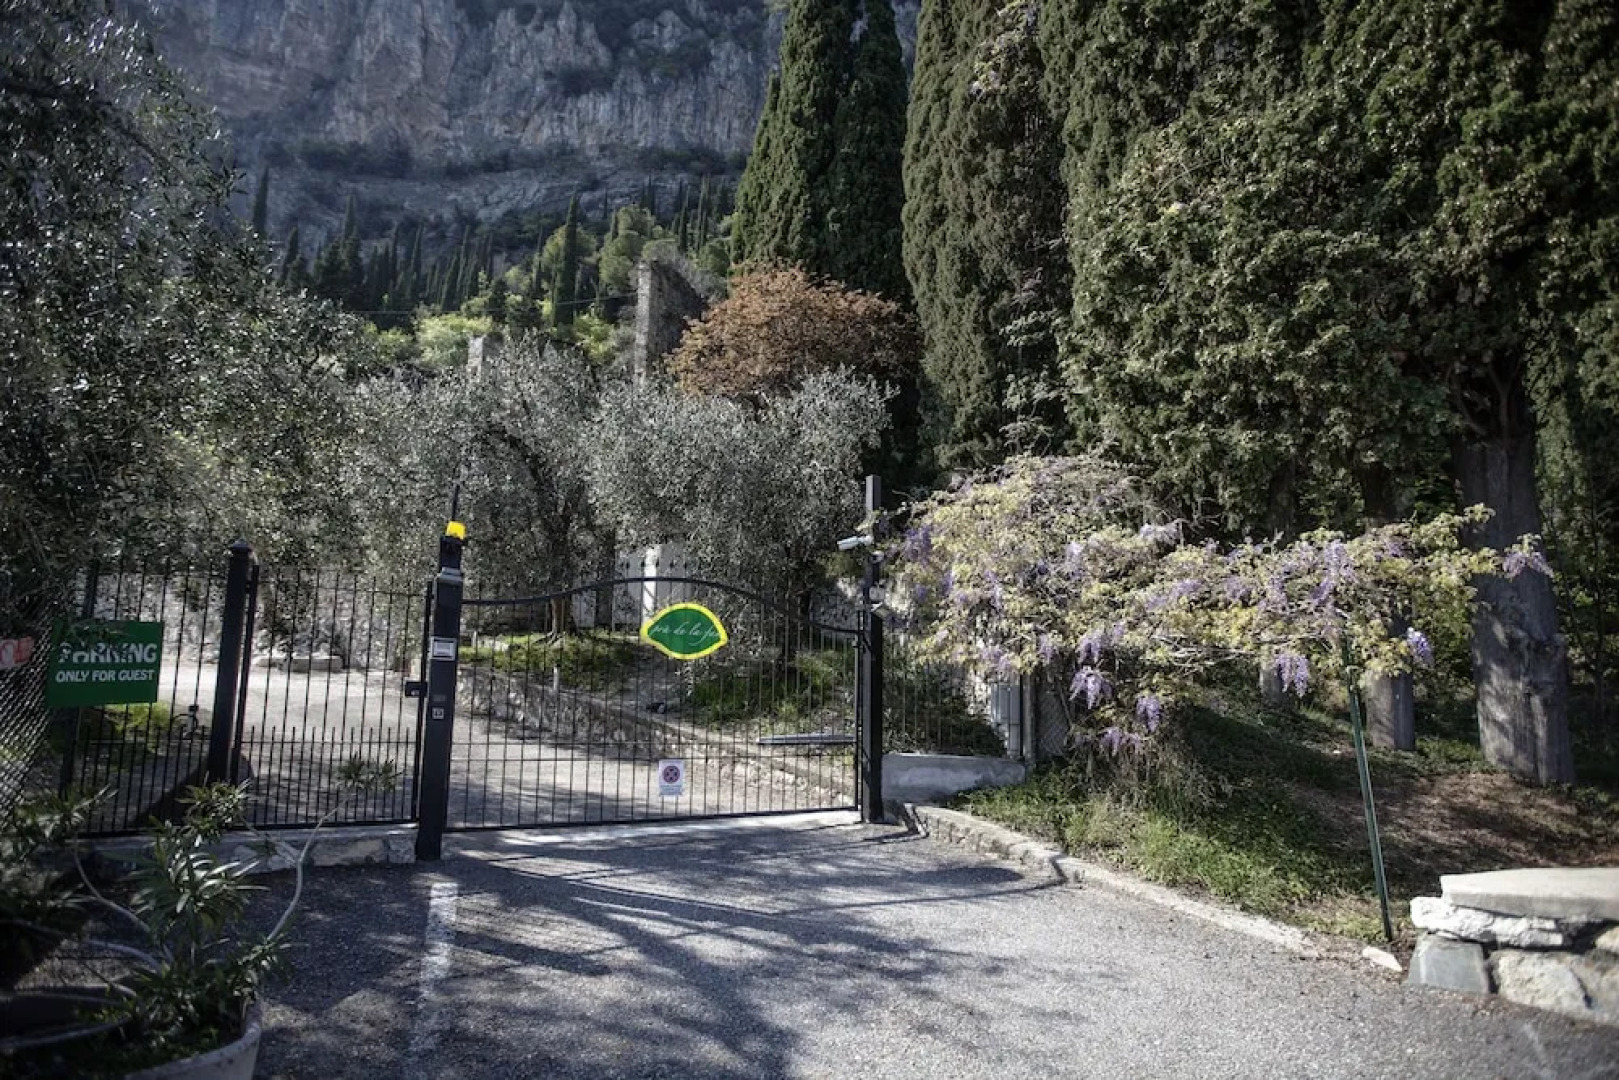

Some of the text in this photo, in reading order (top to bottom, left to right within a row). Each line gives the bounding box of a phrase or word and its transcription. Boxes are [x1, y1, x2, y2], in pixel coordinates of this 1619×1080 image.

[55, 669, 155, 683] ONLY FOR GUEST
